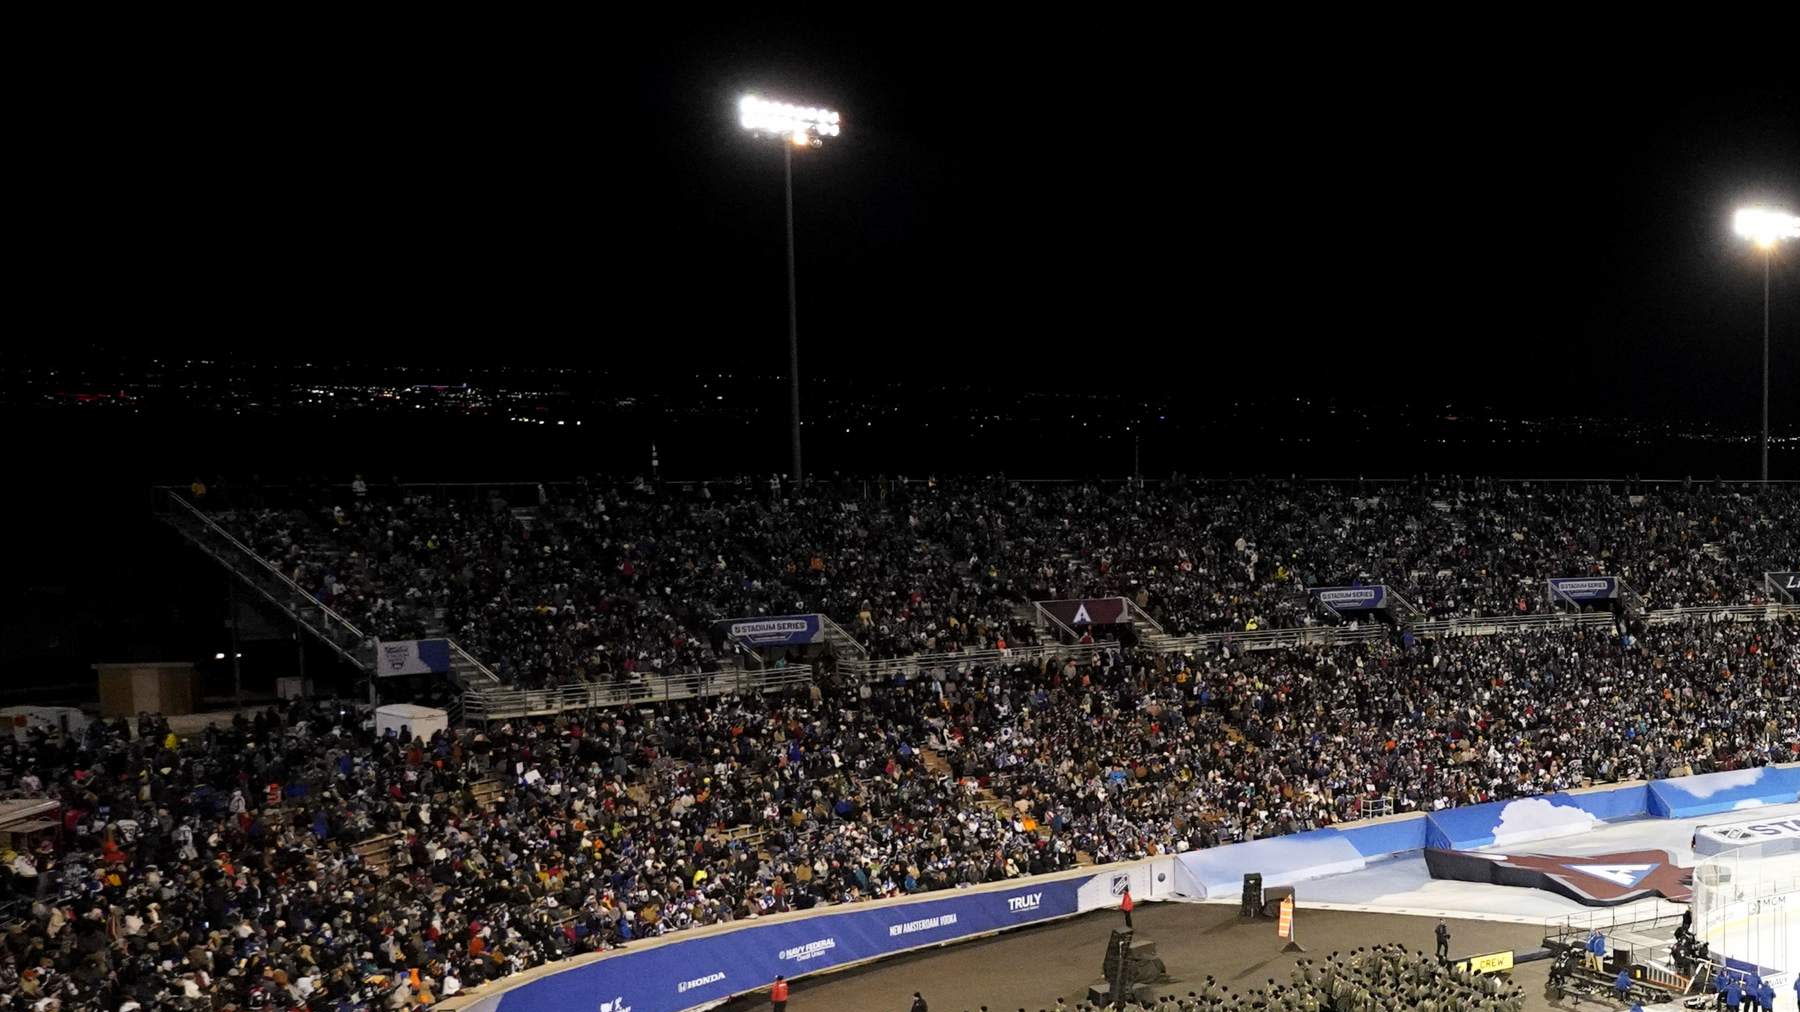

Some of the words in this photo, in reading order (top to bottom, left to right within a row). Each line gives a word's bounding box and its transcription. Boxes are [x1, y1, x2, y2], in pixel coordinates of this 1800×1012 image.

[742, 623, 776, 633] STADIUM
[776, 621, 805, 630] SERIES
[1008, 893, 1042, 910] TRULY
[889, 924, 902, 936] NEW
[902, 917, 939, 935] AMSTERDAM
[806, 938, 835, 951] FEDERAL
[1480, 959, 1503, 969] CREW
[687, 972, 727, 990] HONDA
